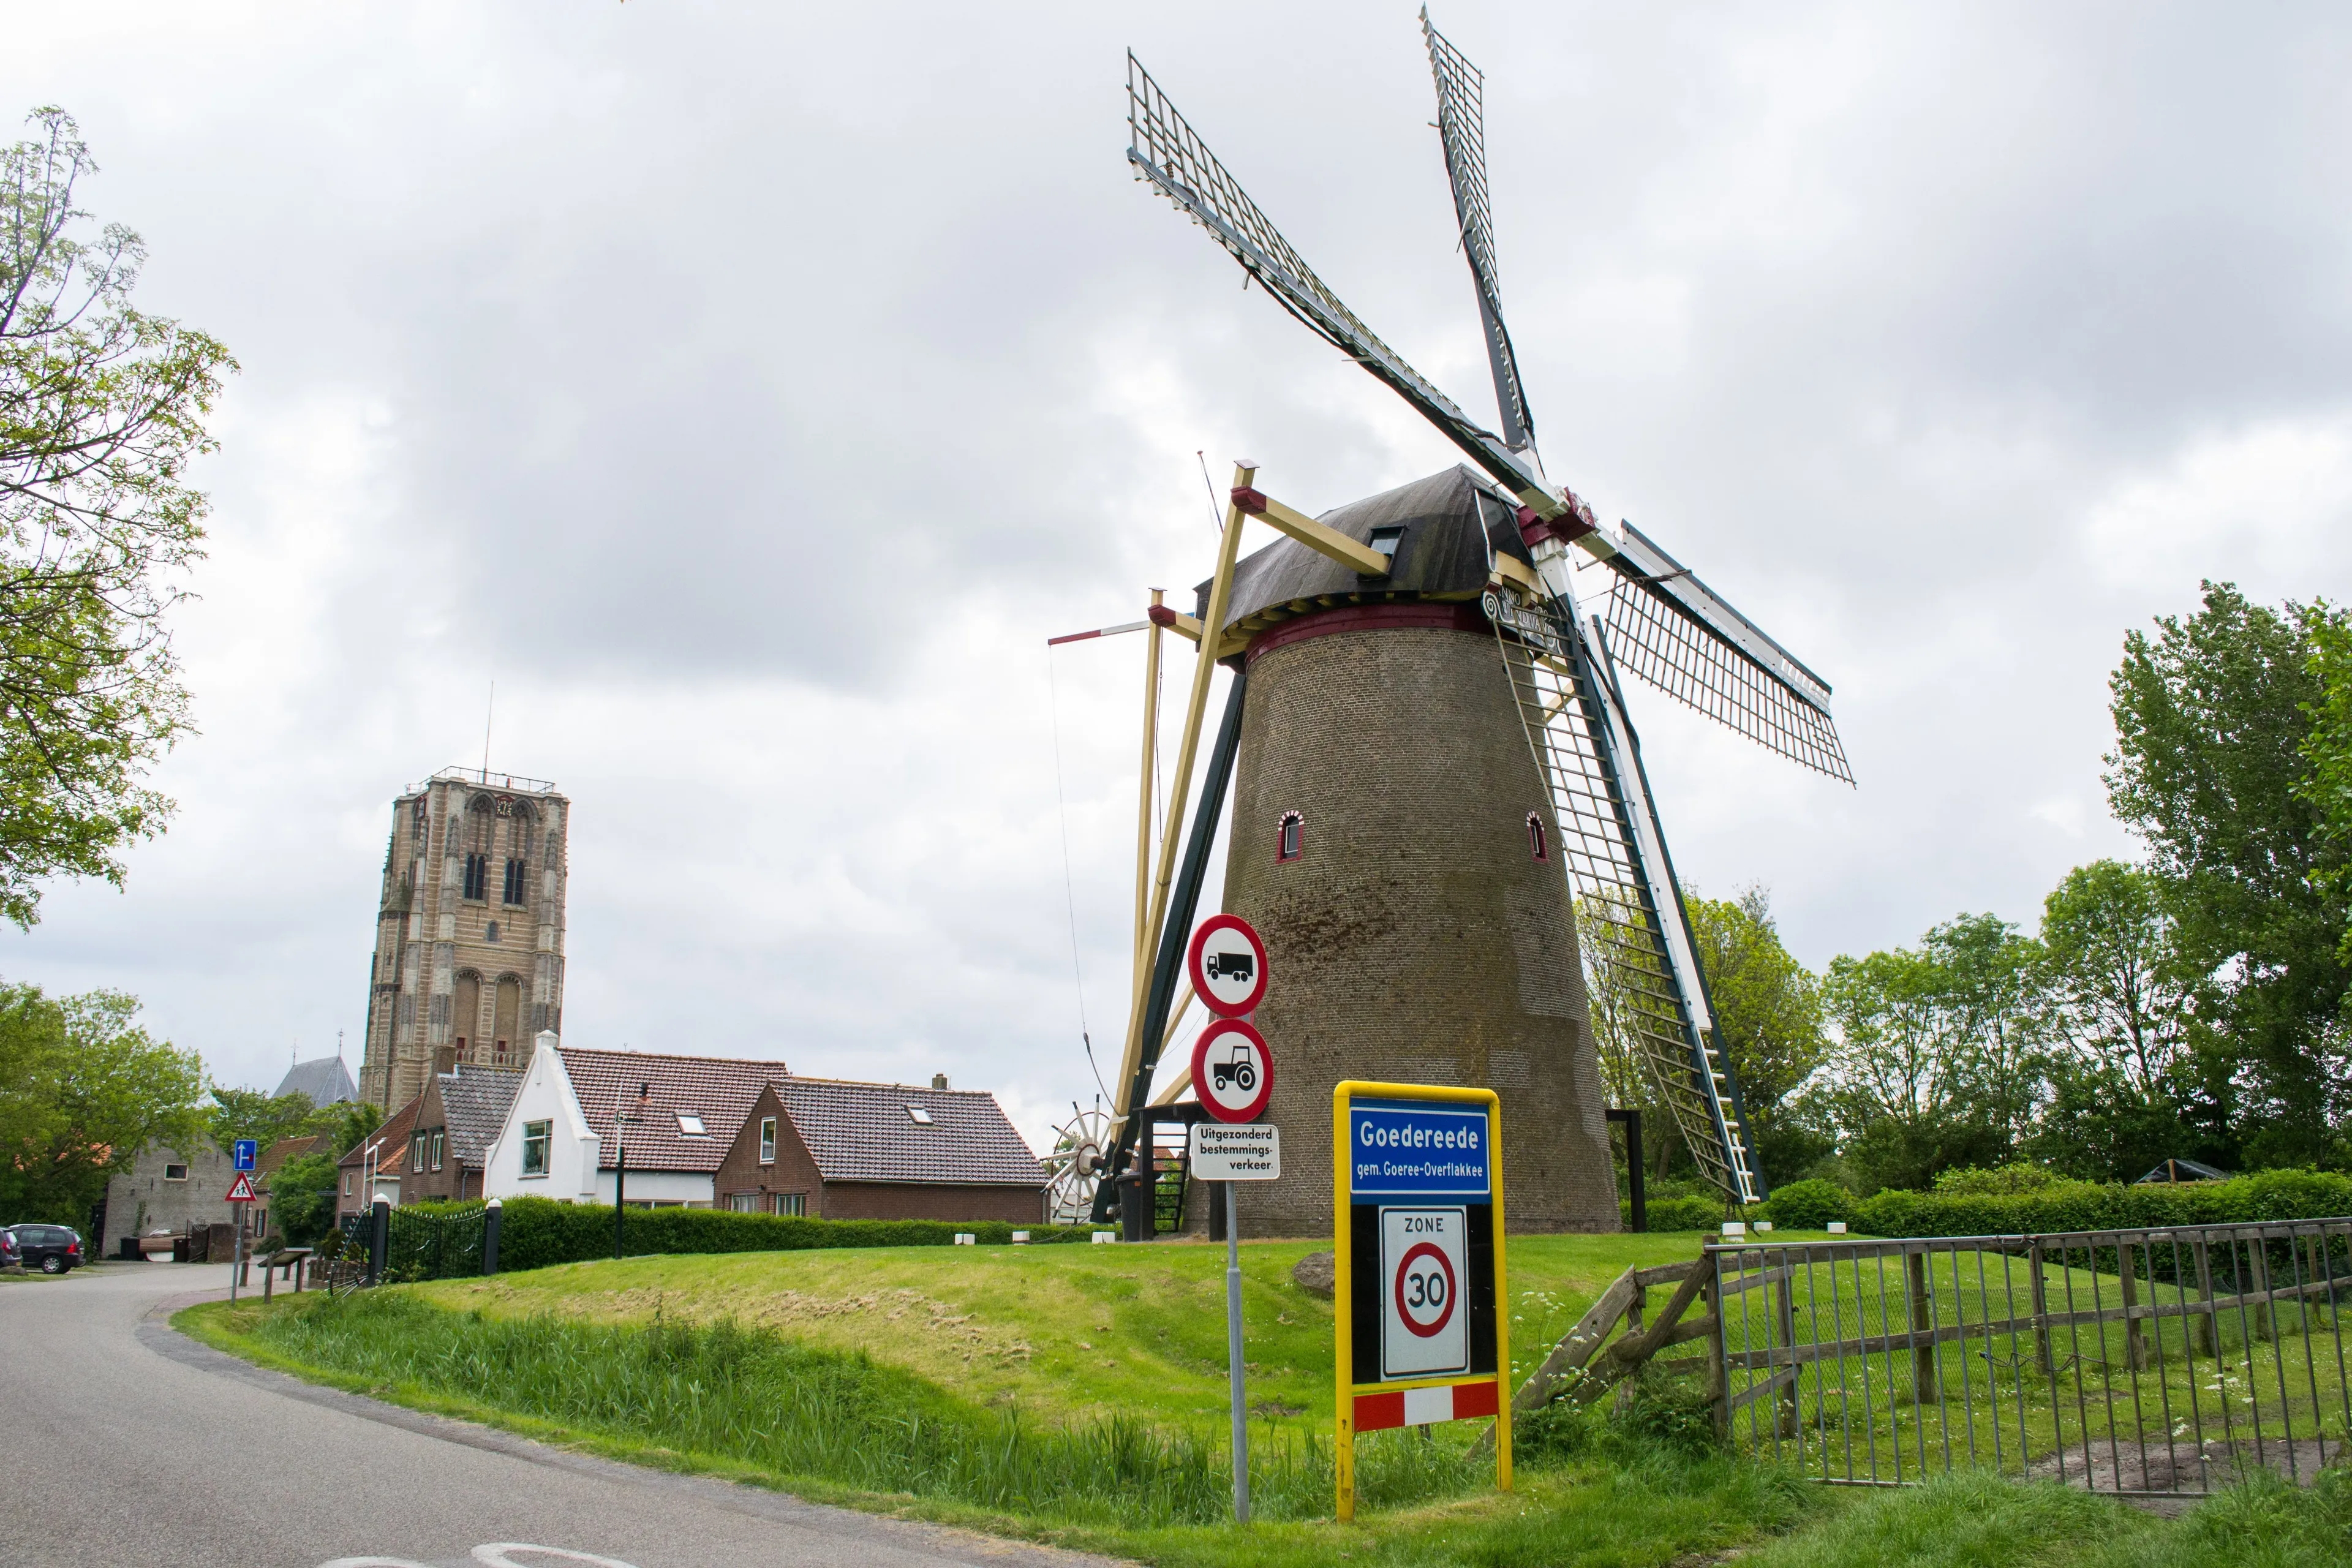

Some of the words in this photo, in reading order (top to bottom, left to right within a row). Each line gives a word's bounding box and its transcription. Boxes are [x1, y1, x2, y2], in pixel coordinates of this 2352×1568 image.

[1200, 1128, 1272, 1142] Uitgezonderd
[1360, 1120, 1479, 1150] Goedereede
[1200, 1143, 1273, 1158] bestemmings-
[1357, 1163, 1381, 1180] gem.
[1384, 1161, 1483, 1177] Goeree-Overflakkee
[1404, 1217, 1444, 1232] ZONE
[1408, 1272, 1445, 1308] 30
